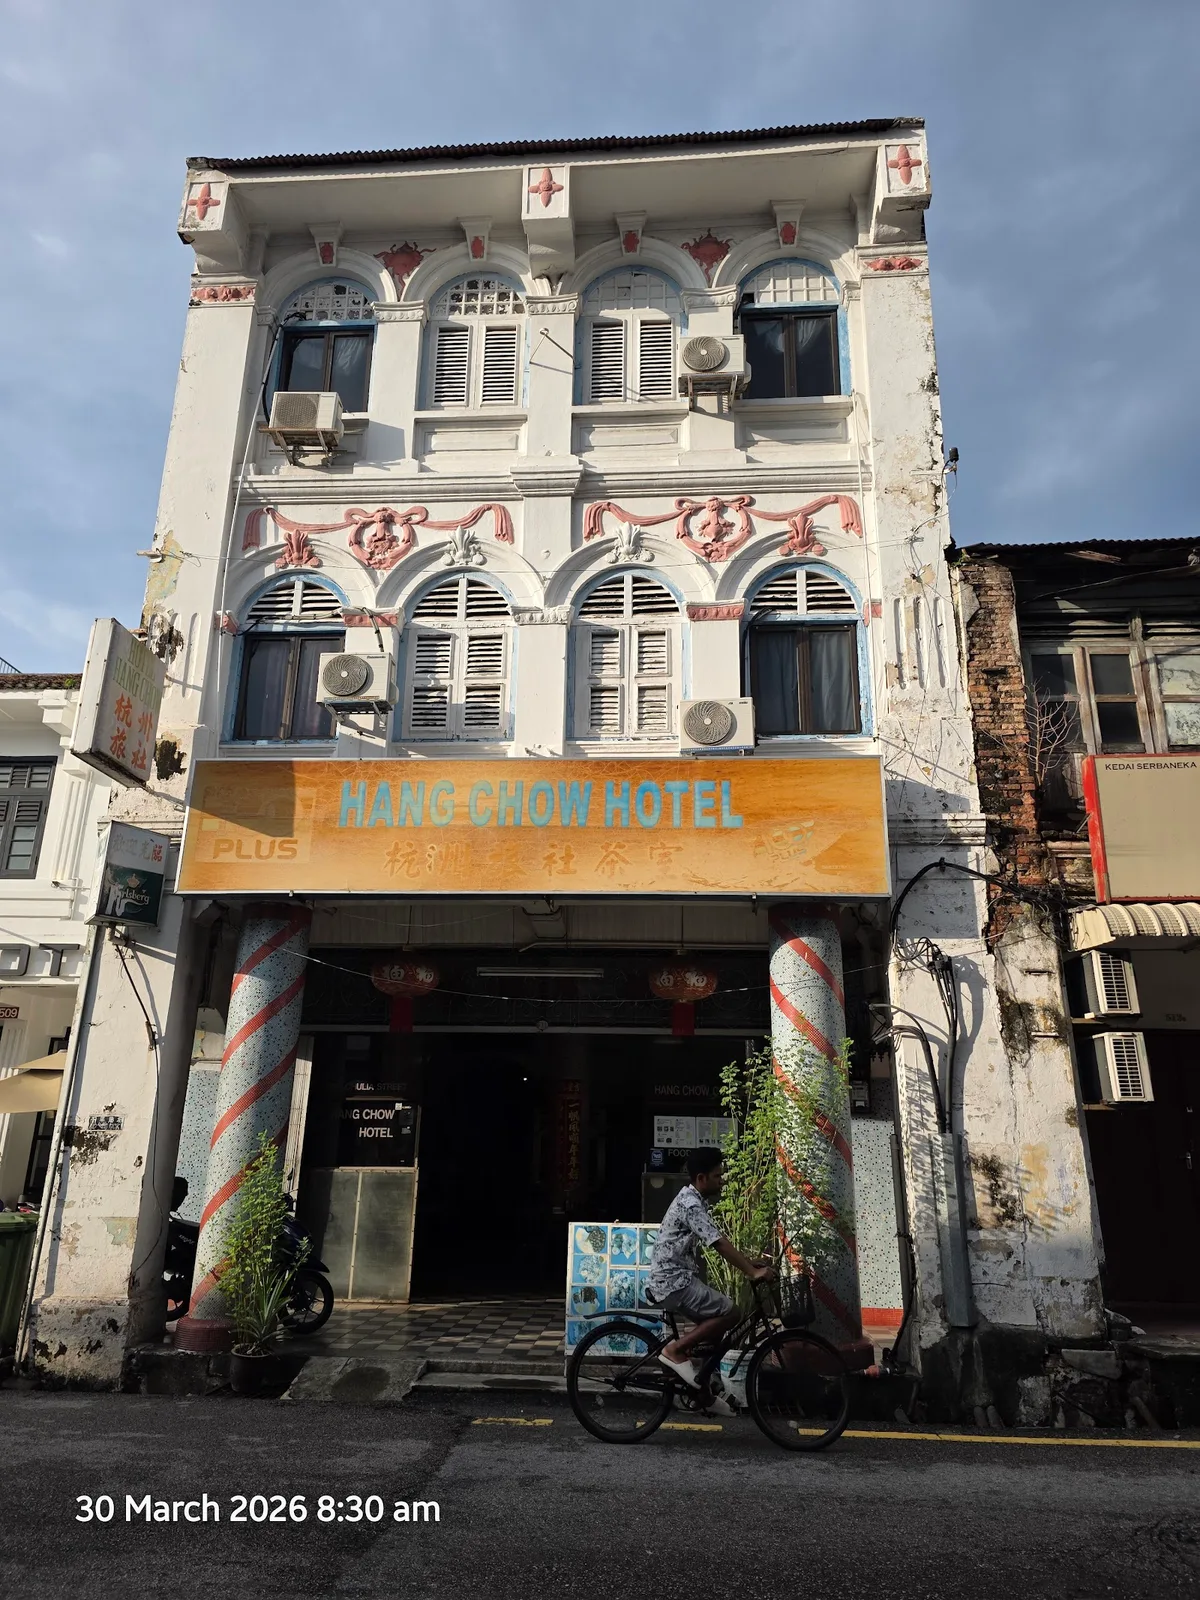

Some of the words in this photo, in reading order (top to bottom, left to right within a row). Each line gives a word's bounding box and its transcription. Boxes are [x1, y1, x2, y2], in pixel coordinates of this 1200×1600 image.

[113, 656, 141, 697] HANG
[114, 692, 154, 742] 杭州
[110, 726, 147, 770] 旅社
[1105, 763, 1135, 771] KEDAI
[1137, 761, 1197, 770] SERBANEKA
[338, 779, 455, 828] HANG
[468, 779, 593, 828] CHOW
[604, 779, 744, 828] HOTEL
[213, 839, 298, 860] PLUS
[654, 1085, 680, 1096] HANG
[682, 1085, 709, 1096] CHOW
[362, 1109, 395, 1120] CHOW
[358, 1127, 393, 1138] HOTEL
